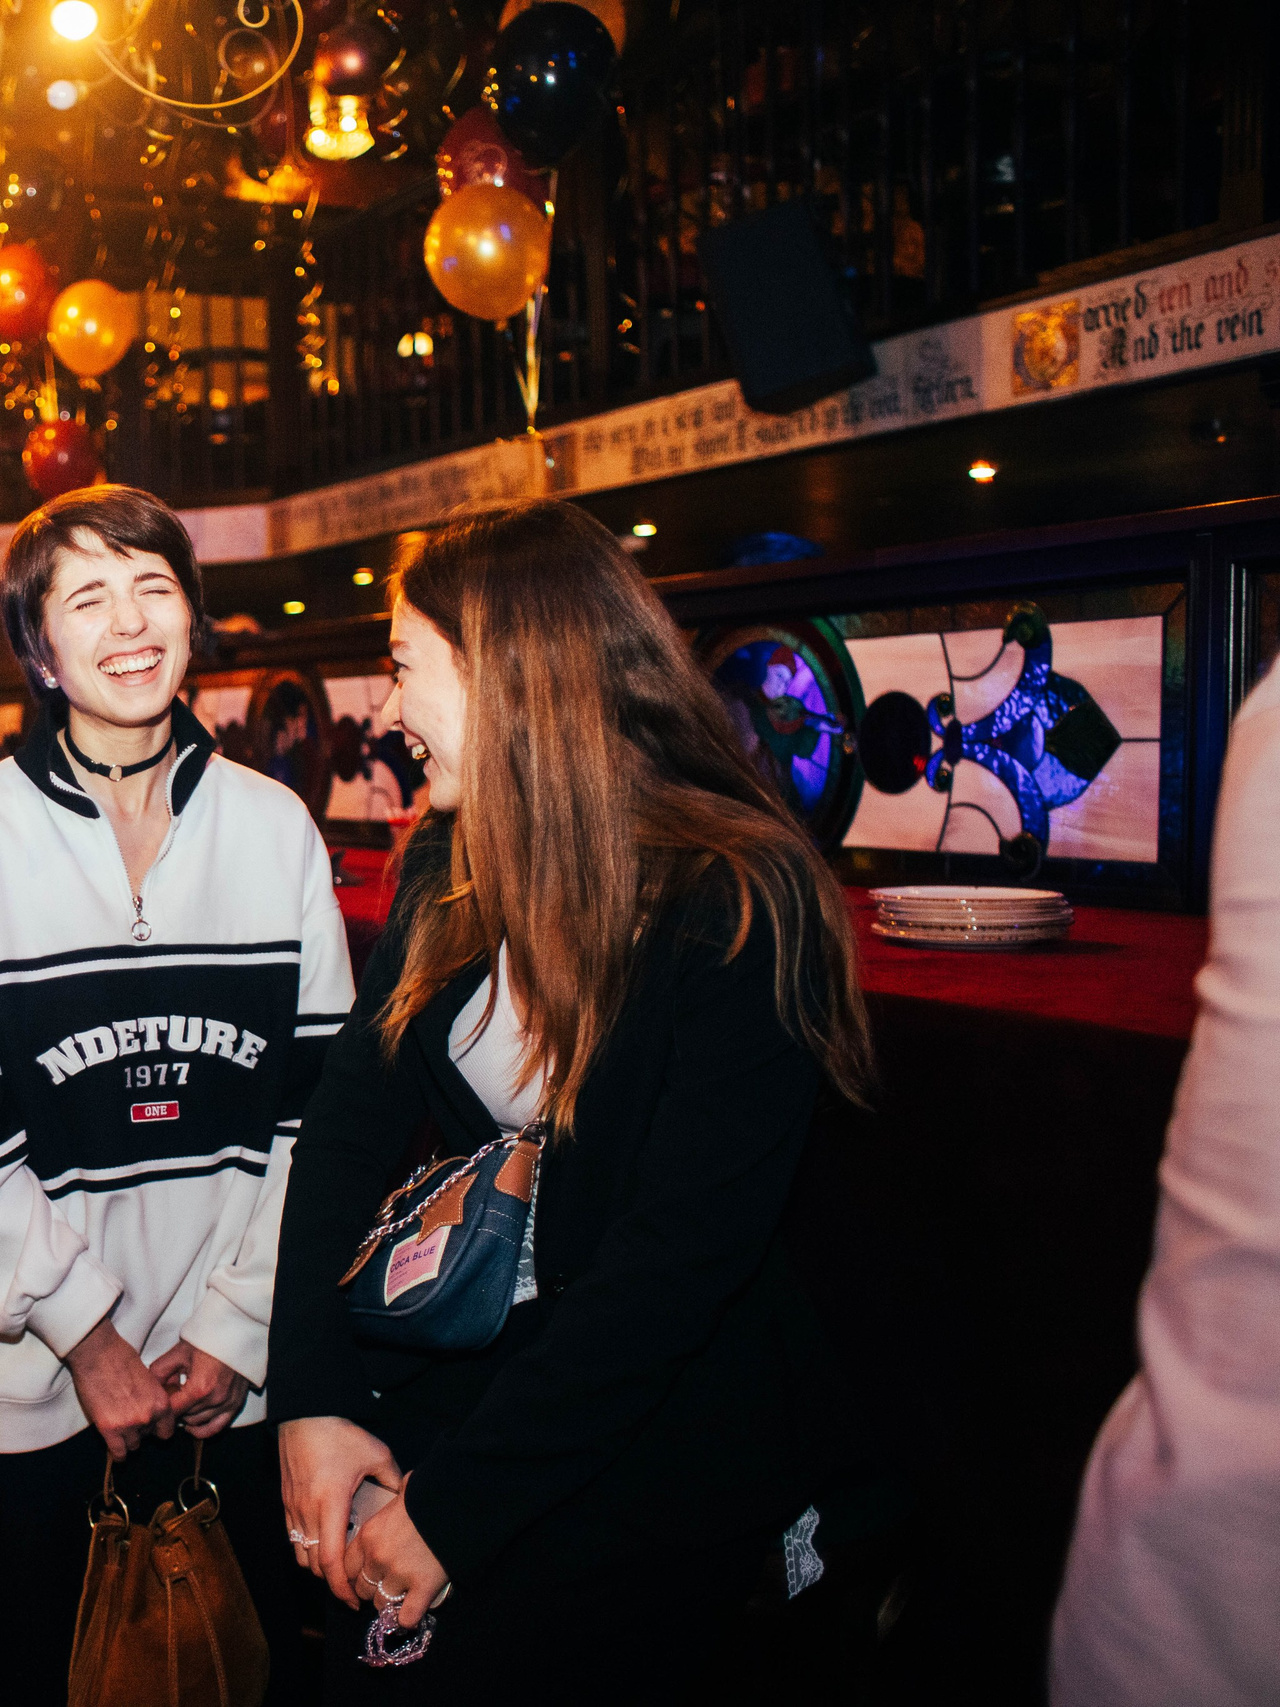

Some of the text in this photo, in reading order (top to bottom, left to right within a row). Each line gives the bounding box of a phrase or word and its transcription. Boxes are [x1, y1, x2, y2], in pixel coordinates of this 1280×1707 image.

[1203, 257, 1250, 304] and
[1170, 315, 1205, 354] the
[35, 1014, 268, 1086] NDETURE
[124, 1062, 190, 1089] 1977
[144, 1105, 168, 1118] ONE
[412, 1245, 436, 1261] BLUE
